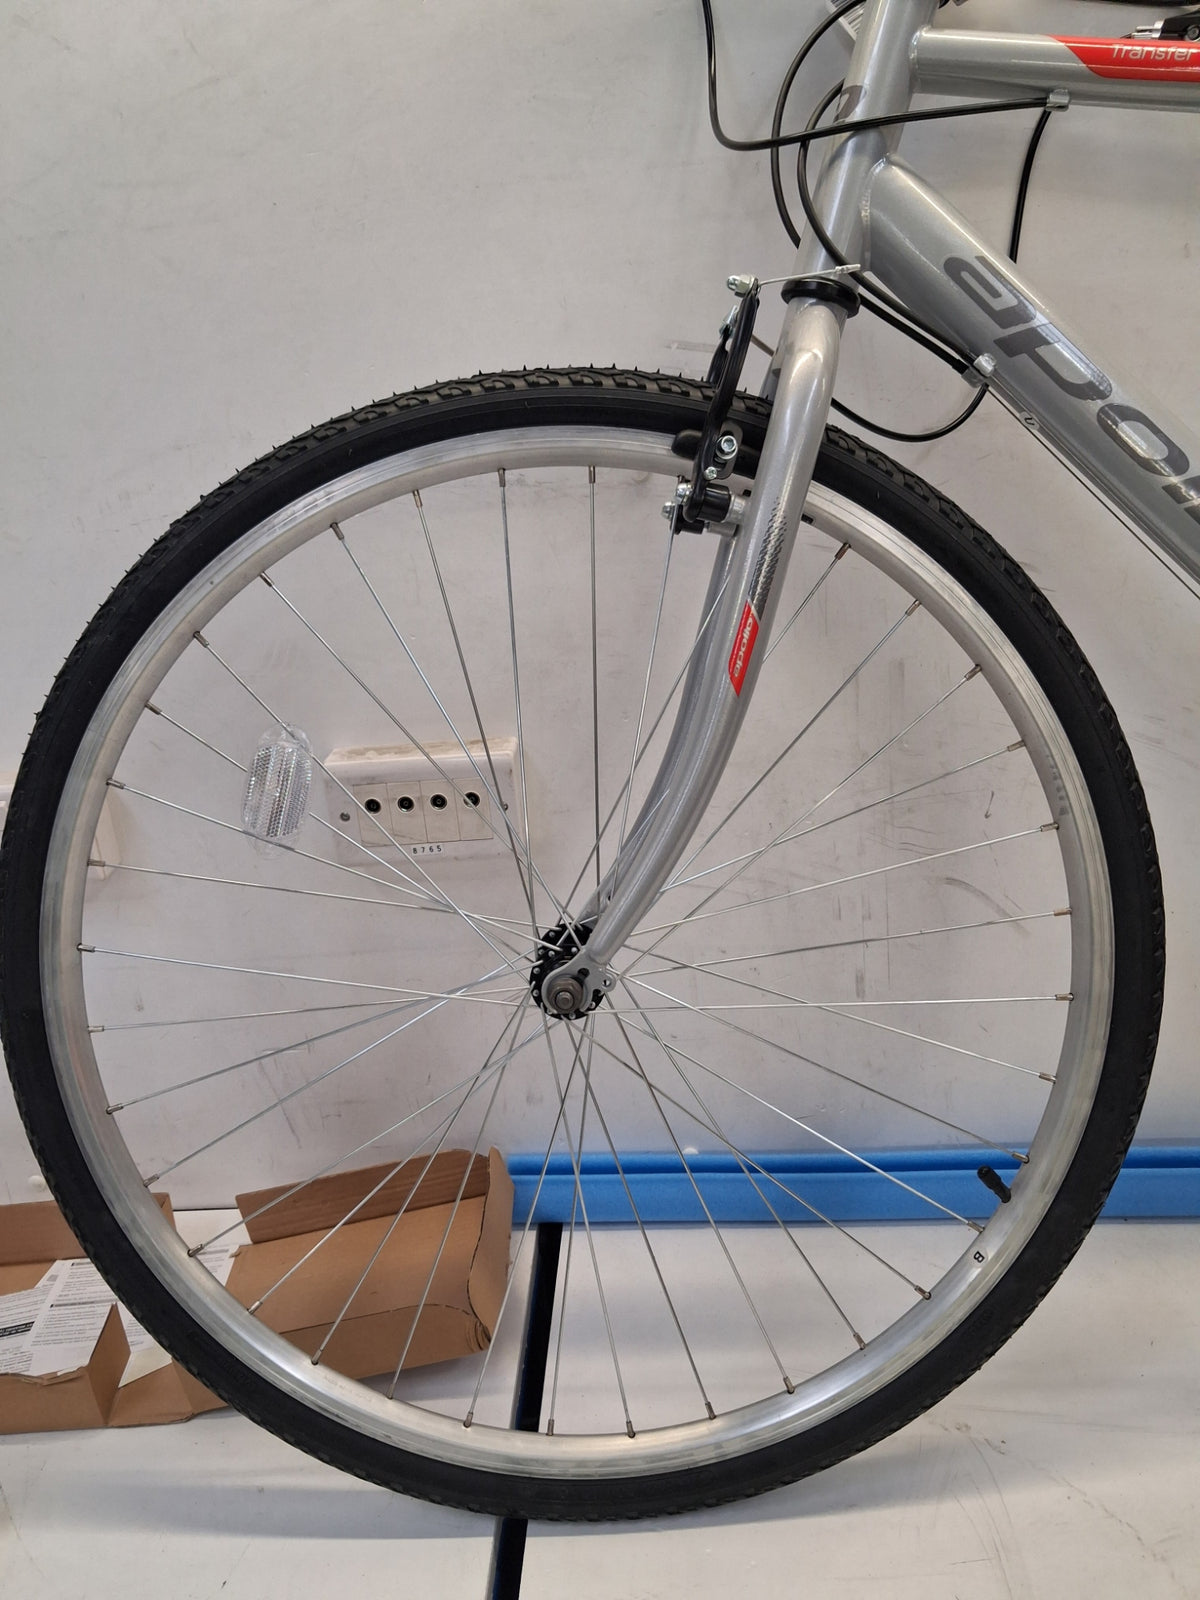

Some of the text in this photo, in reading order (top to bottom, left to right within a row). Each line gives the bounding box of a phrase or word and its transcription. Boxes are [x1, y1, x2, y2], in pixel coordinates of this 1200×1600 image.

[1111, 43, 1198, 61] Transfer
[733, 617, 753, 678] apollo
[973, 1250, 985, 1263] B
